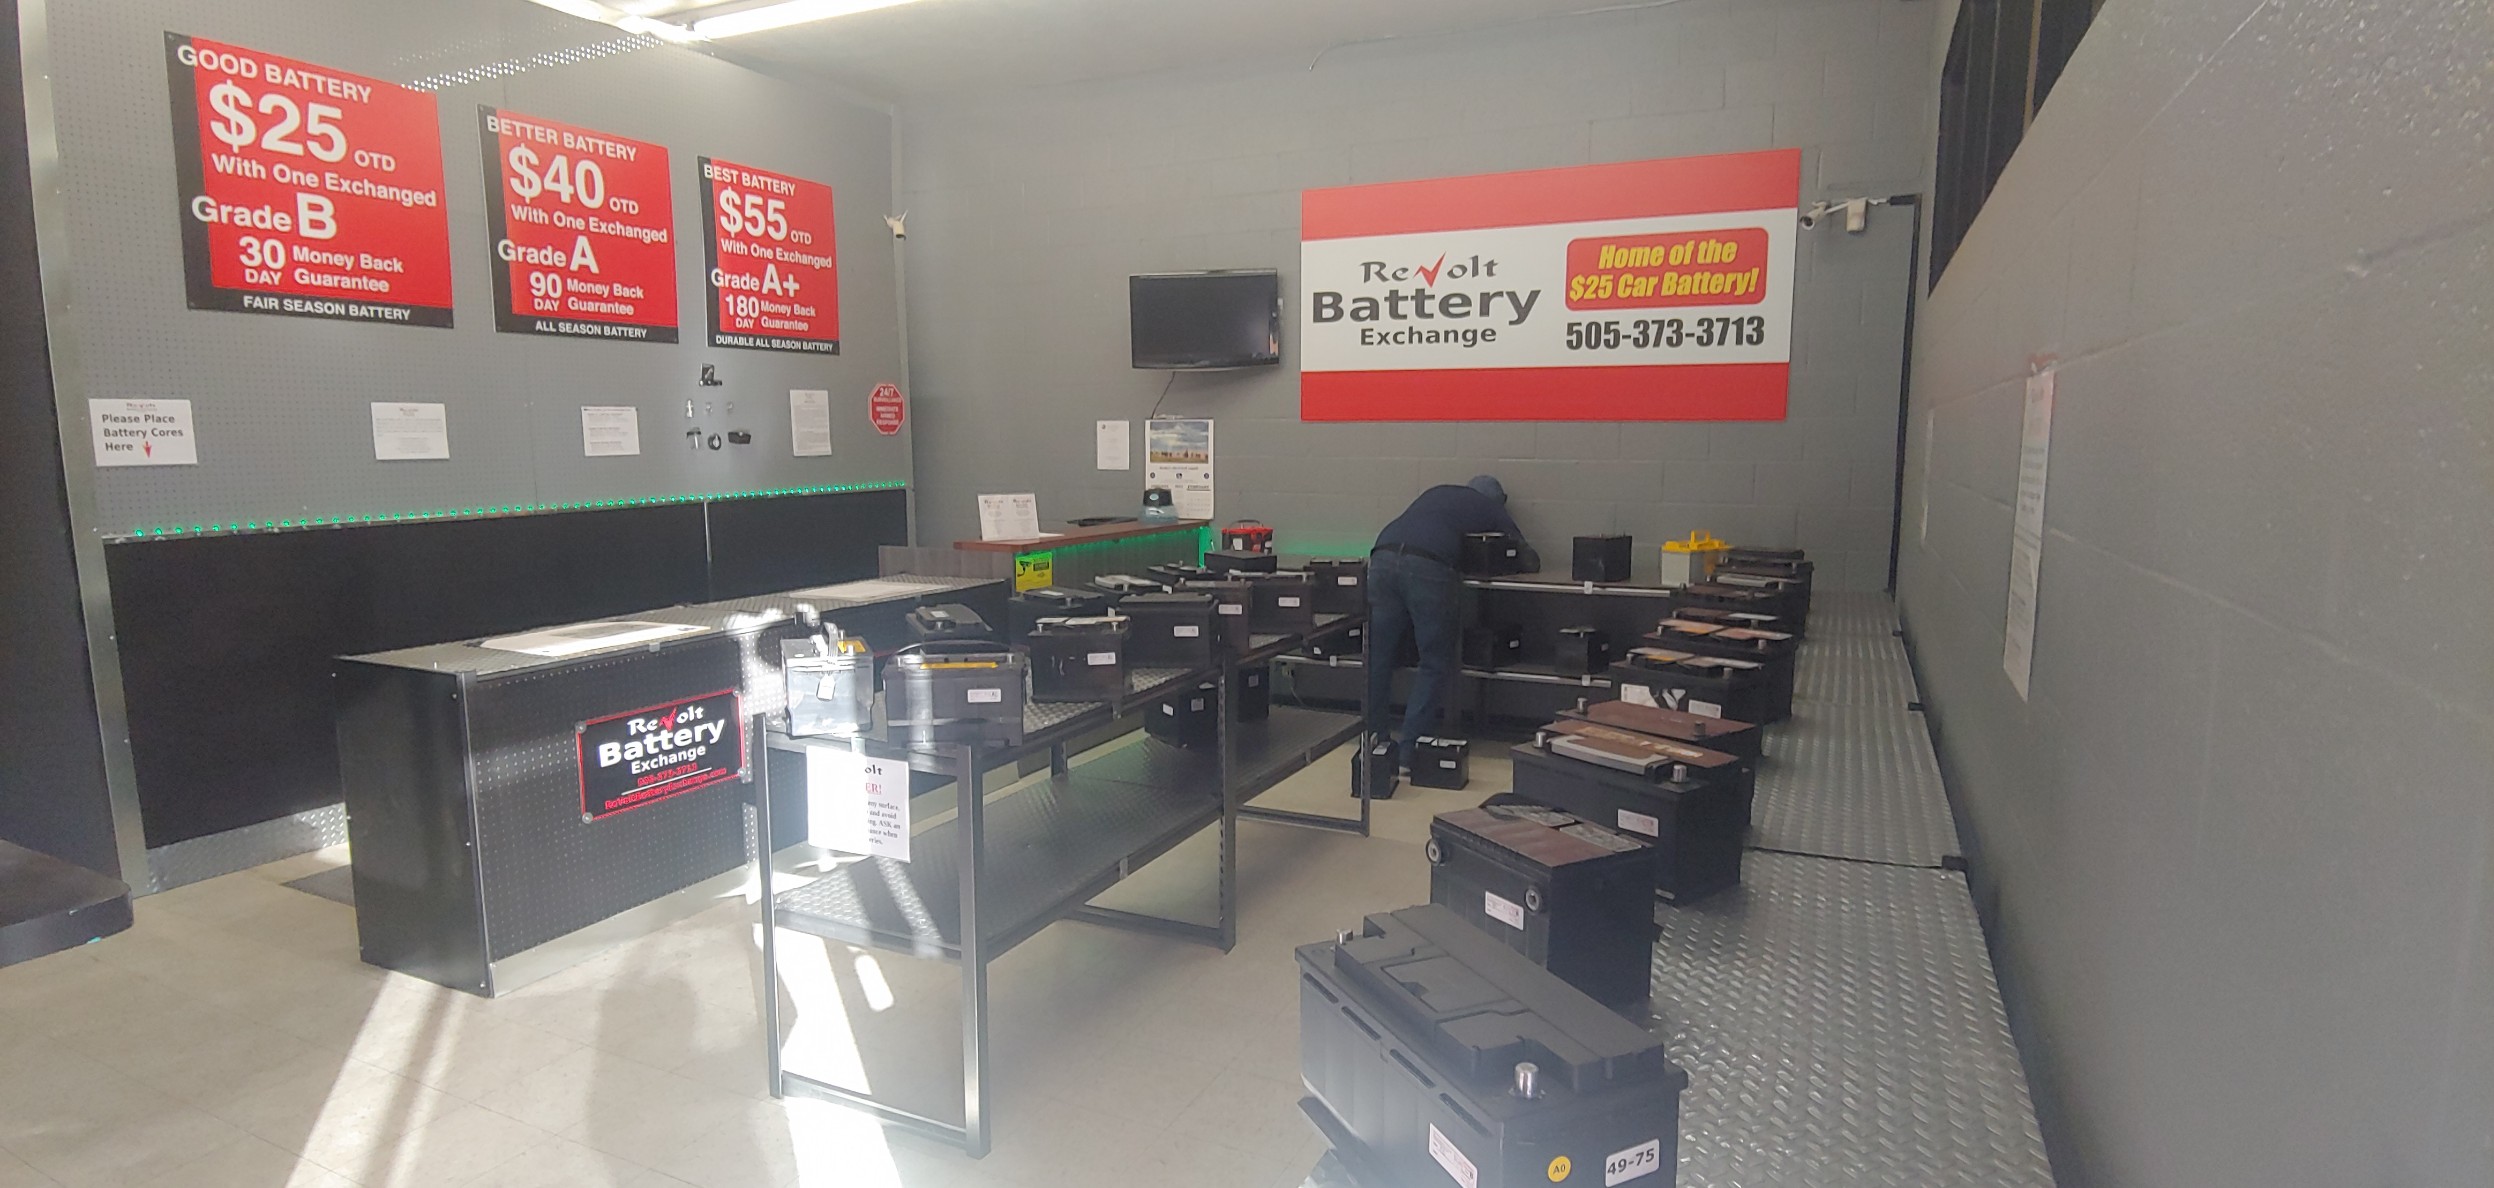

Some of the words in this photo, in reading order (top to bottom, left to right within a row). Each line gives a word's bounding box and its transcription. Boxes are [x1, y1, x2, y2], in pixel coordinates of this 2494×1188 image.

[177, 45, 257, 78] GOOD
[265, 63, 371, 103] BATTERY
[209, 79, 347, 162] $25
[354, 150, 396, 171] OTD
[487, 115, 558, 144] BETTER
[563, 131, 636, 161] BATTERY
[212, 153, 265, 179] With
[273, 164, 319, 188] One
[325, 172, 437, 207] Exchanged
[508, 143, 604, 208] $40
[609, 197, 639, 214] OTD
[704, 164, 738, 184] BEST
[742, 172, 795, 196] BATTERY
[192, 196, 292, 231] Grade
[296, 192, 336, 239] B
[511, 204, 548, 225] With
[553, 211, 586, 230] One
[589, 216, 668, 243] Exchanged
[719, 186, 787, 241] $55
[790, 230, 812, 245] OTD
[239, 236, 285, 269] 30
[293, 245, 354, 270] Money
[360, 253, 404, 272] Back
[497, 239, 566, 268] Grade
[570, 235, 599, 273] A
[721, 238, 748, 256] With
[750, 243, 773, 260] One
[775, 246, 832, 269] Exchanged
[1598, 243, 1664, 271] Home
[1668, 241, 1694, 266] of
[1695, 239, 1738, 263] the
[245, 269, 281, 285] DAY
[294, 268, 389, 292] Guarantee
[530, 272, 562, 298] 90
[567, 279, 609, 299] Money
[613, 284, 644, 299] Back
[711, 268, 760, 291] Grade
[762, 264, 800, 297] A+
[1570, 272, 1613, 302] $25
[1617, 271, 1657, 298] Car
[1661, 267, 1758, 296] Battery!
[243, 295, 278, 310] FAIR
[283, 299, 345, 315] SEASON
[349, 304, 410, 320] BATTERY
[534, 298, 559, 312] DAY
[568, 298, 634, 316] Guarantee
[725, 294, 759, 319] 180
[760, 302, 791, 318] Money
[793, 304, 816, 317] Back
[1311, 285, 1542, 326] Battery
[535, 320, 555, 332] ALL
[558, 322, 601, 335] SEASON
[603, 325, 647, 339] BATTERY
[735, 317, 755, 329] DAY
[761, 316, 809, 332] Guarantee
[1360, 325, 1497, 348] Exchange
[1565, 316, 1765, 350] 505-373-3713
[715, 335, 753, 346] DURABLE
[755, 337, 770, 347] ALL
[771, 338, 801, 350] SEASON
[802, 340, 833, 352] BATTERY
[102, 414, 140, 423] Please
[144, 414, 175, 423] Place
[104, 428, 147, 439] Battery
[151, 428, 183, 437] Cores
[105, 442, 133, 451] Here
[598, 719, 725, 767] Battery
[631, 746, 706, 774] Exchange
[1607, 1149, 1655, 1176] 49-75
